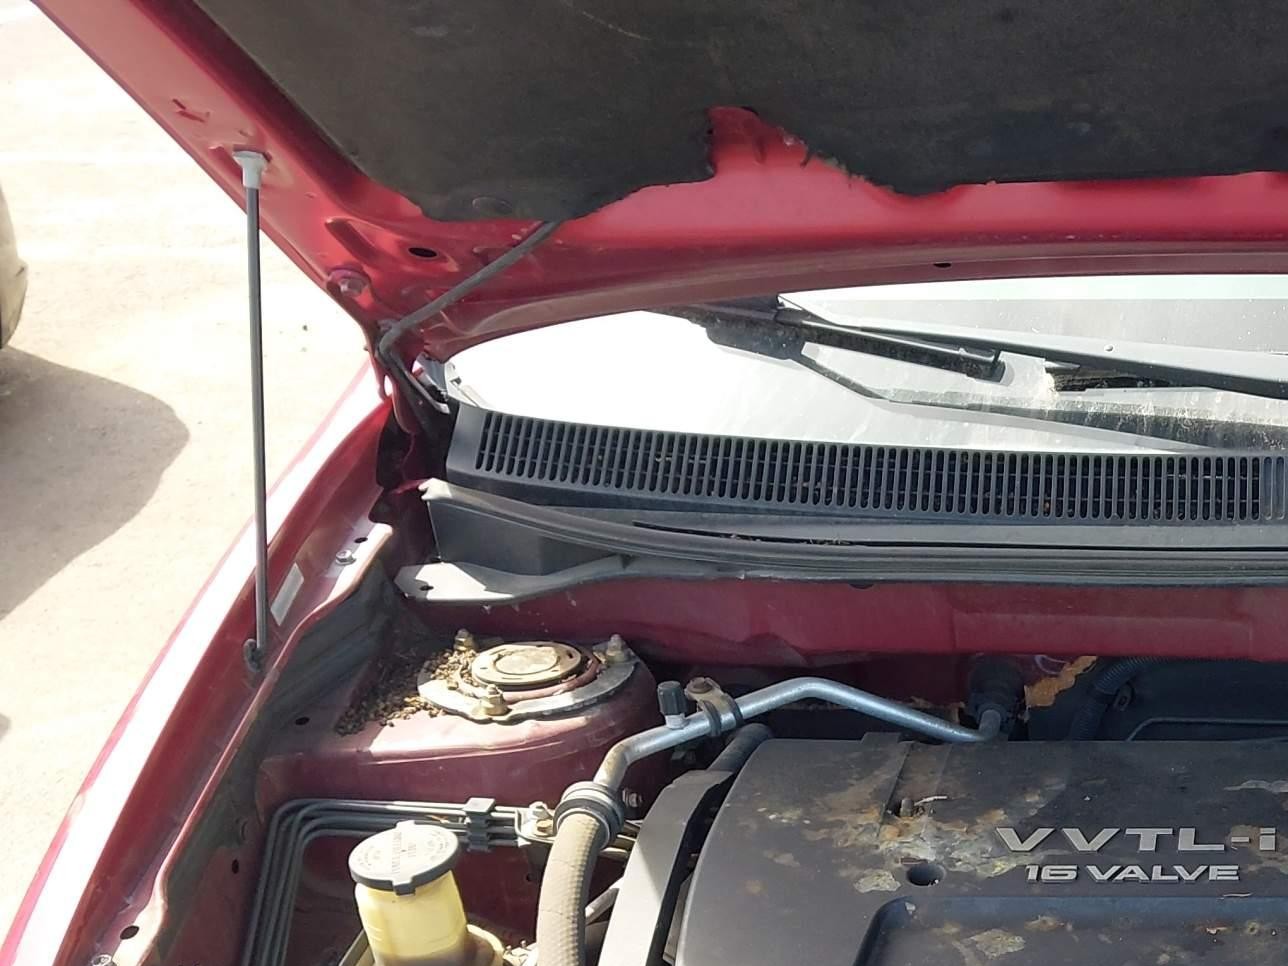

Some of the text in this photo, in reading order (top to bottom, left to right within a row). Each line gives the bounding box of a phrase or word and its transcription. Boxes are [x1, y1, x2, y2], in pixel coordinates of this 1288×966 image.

[996, 826, 1277, 853] VVTL-i
[1024, 865, 1241, 882] 16 VALVE
